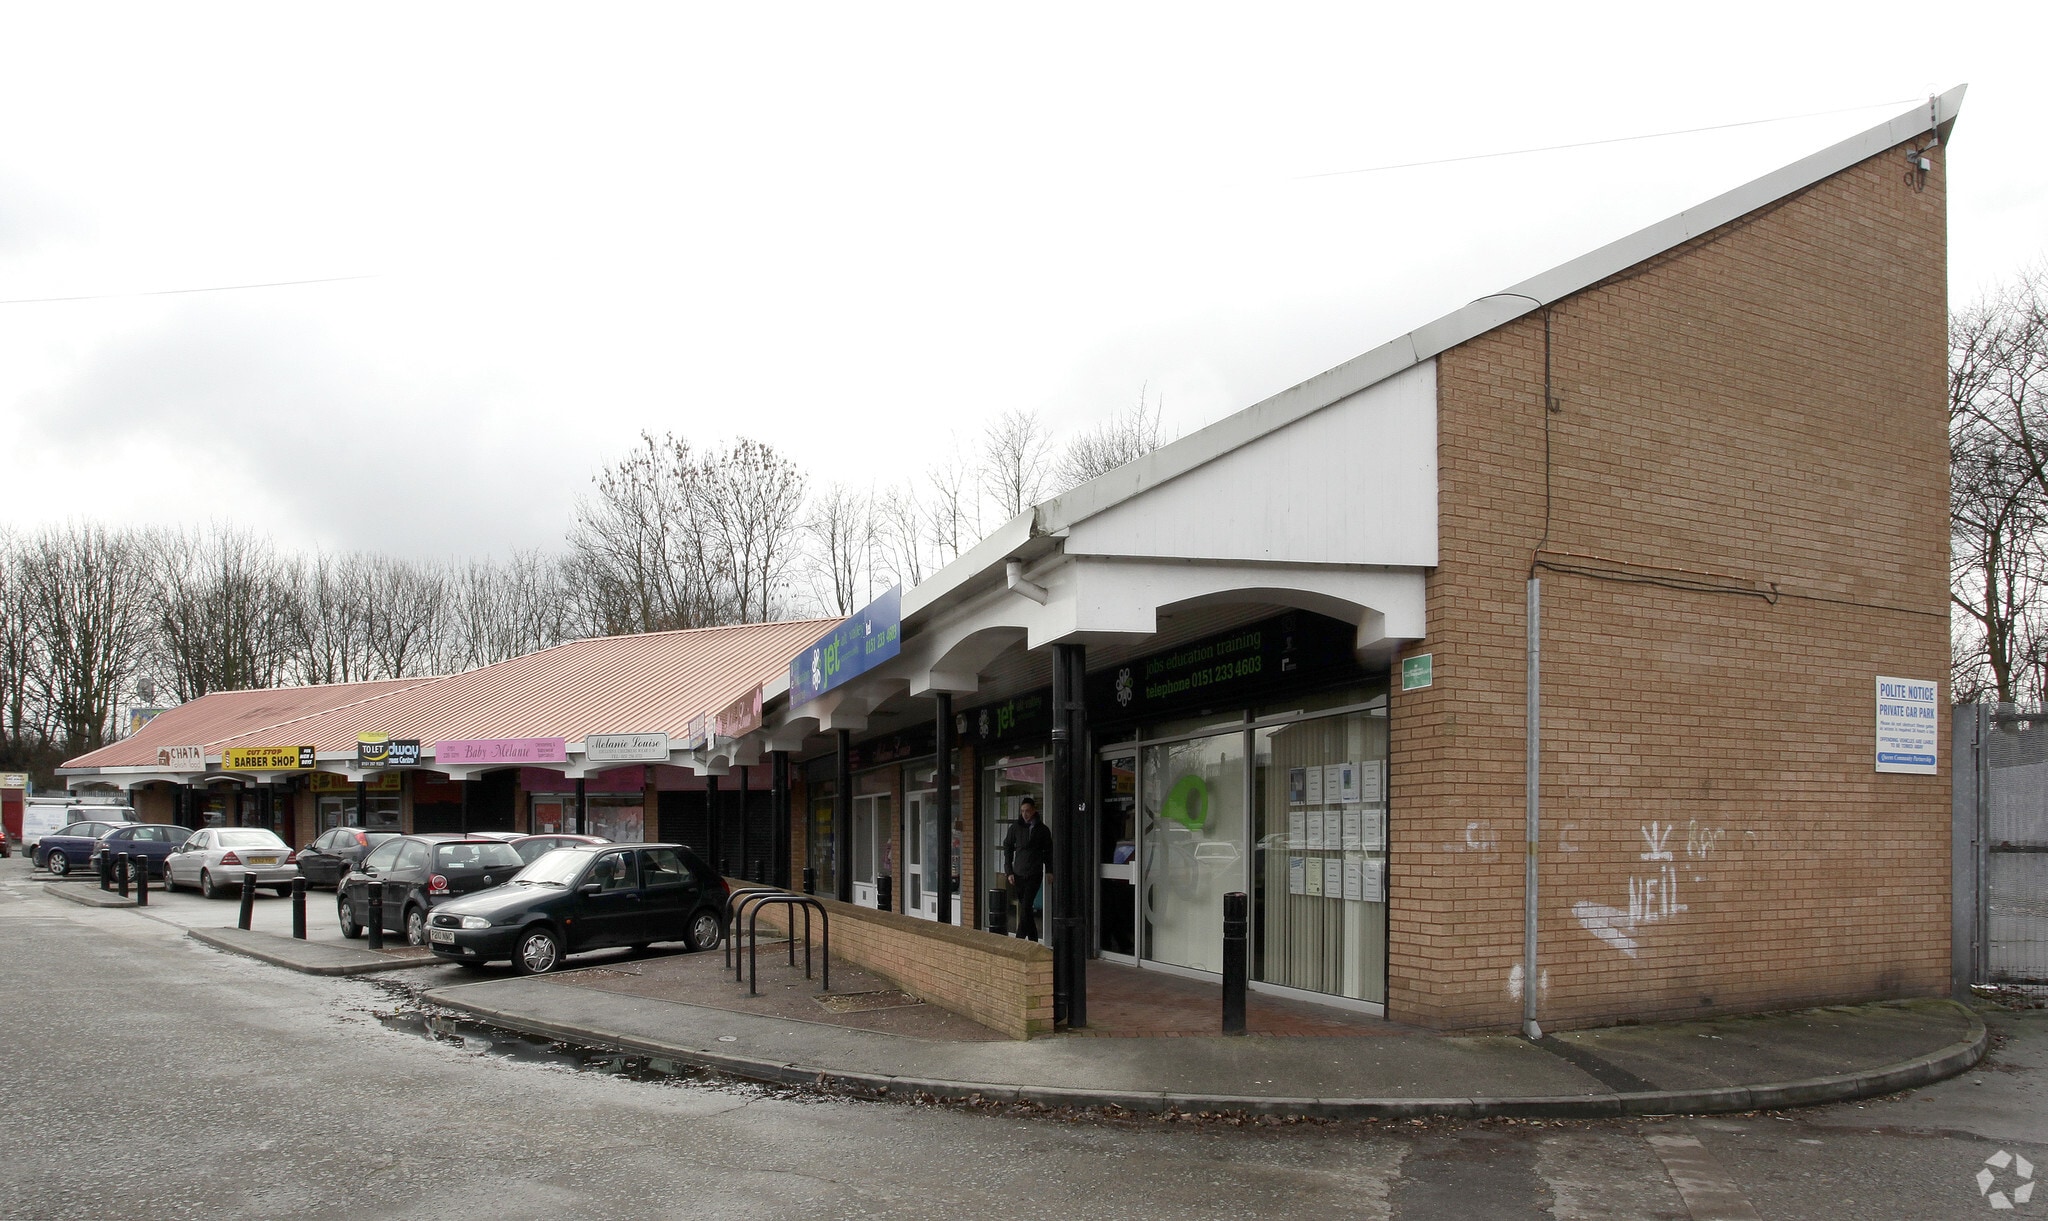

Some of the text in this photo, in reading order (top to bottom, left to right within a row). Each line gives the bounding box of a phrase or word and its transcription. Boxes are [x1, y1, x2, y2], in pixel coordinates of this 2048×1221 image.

[823, 633, 840, 689] jet
[1146, 658, 1164, 681] jobs
[1166, 644, 1214, 670] education
[1216, 631, 1261, 656] training
[1146, 676, 1190, 699] telephone
[1192, 668, 1213, 688] 0151
[1215, 662, 1234, 683] 233
[1235, 655, 1262, 676] 4603
[1880, 683, 1934, 701] POLITE NOTICE
[997, 700, 1015, 737] jet
[1879, 704, 1935, 720] PRIVATE CAR PARK
[362, 745, 384, 754] TO LET
[591, 735, 660, 749] Melanie Louise
[170, 747, 200, 759] CHATA
[464, 743, 530, 760] Baby Melanie
[234, 755, 295, 768] BARBER SHOP
